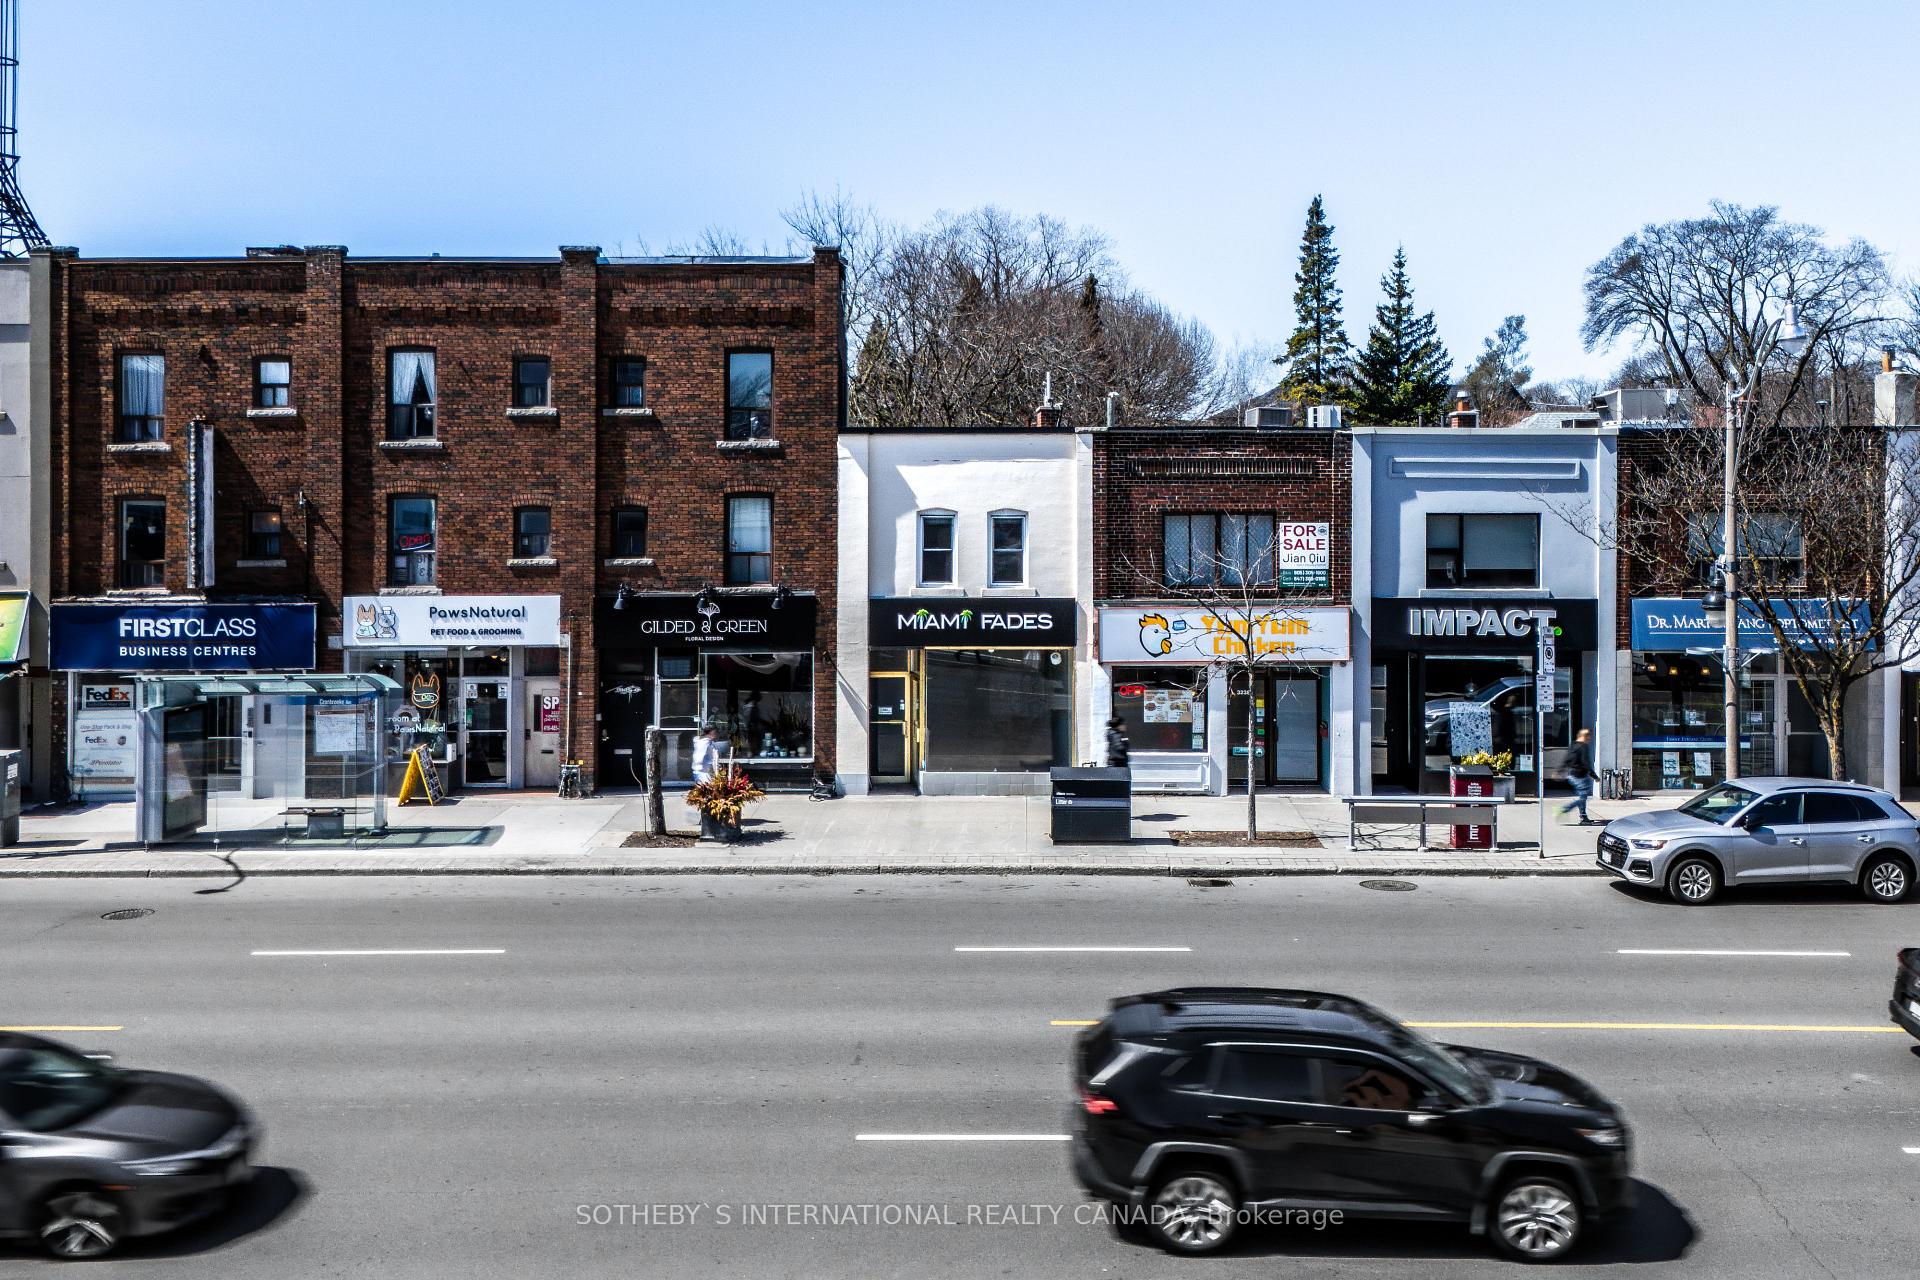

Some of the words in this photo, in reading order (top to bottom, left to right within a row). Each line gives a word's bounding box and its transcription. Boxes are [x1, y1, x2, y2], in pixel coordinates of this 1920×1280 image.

[1284, 525, 1316, 536] FOR
[400, 534, 430, 547] Open
[1284, 539, 1325, 550] SALE
[1283, 554, 1305, 562] Jian
[1310, 553, 1325, 564] Qiu
[429, 606, 526, 619] PawsNatural
[641, 620, 696, 633] GILDED
[701, 620, 712, 633] &
[716, 620, 767, 632] GREEN
[897, 610, 972, 630] MIAMI
[981, 613, 1054, 630] FADES
[1737, 614, 1765, 629] ANG
[119, 618, 257, 637] FIRSTCLASS
[119, 646, 187, 656] BUSINESS
[193, 646, 257, 656] CENTRES
[1213, 637, 1295, 655] Chiken
[86, 687, 129, 701] FedEx
[543, 696, 560, 710] SP
[386, 714, 410, 722] room
[411, 713, 420, 722] at
[394, 723, 446, 733] PawsNatural
